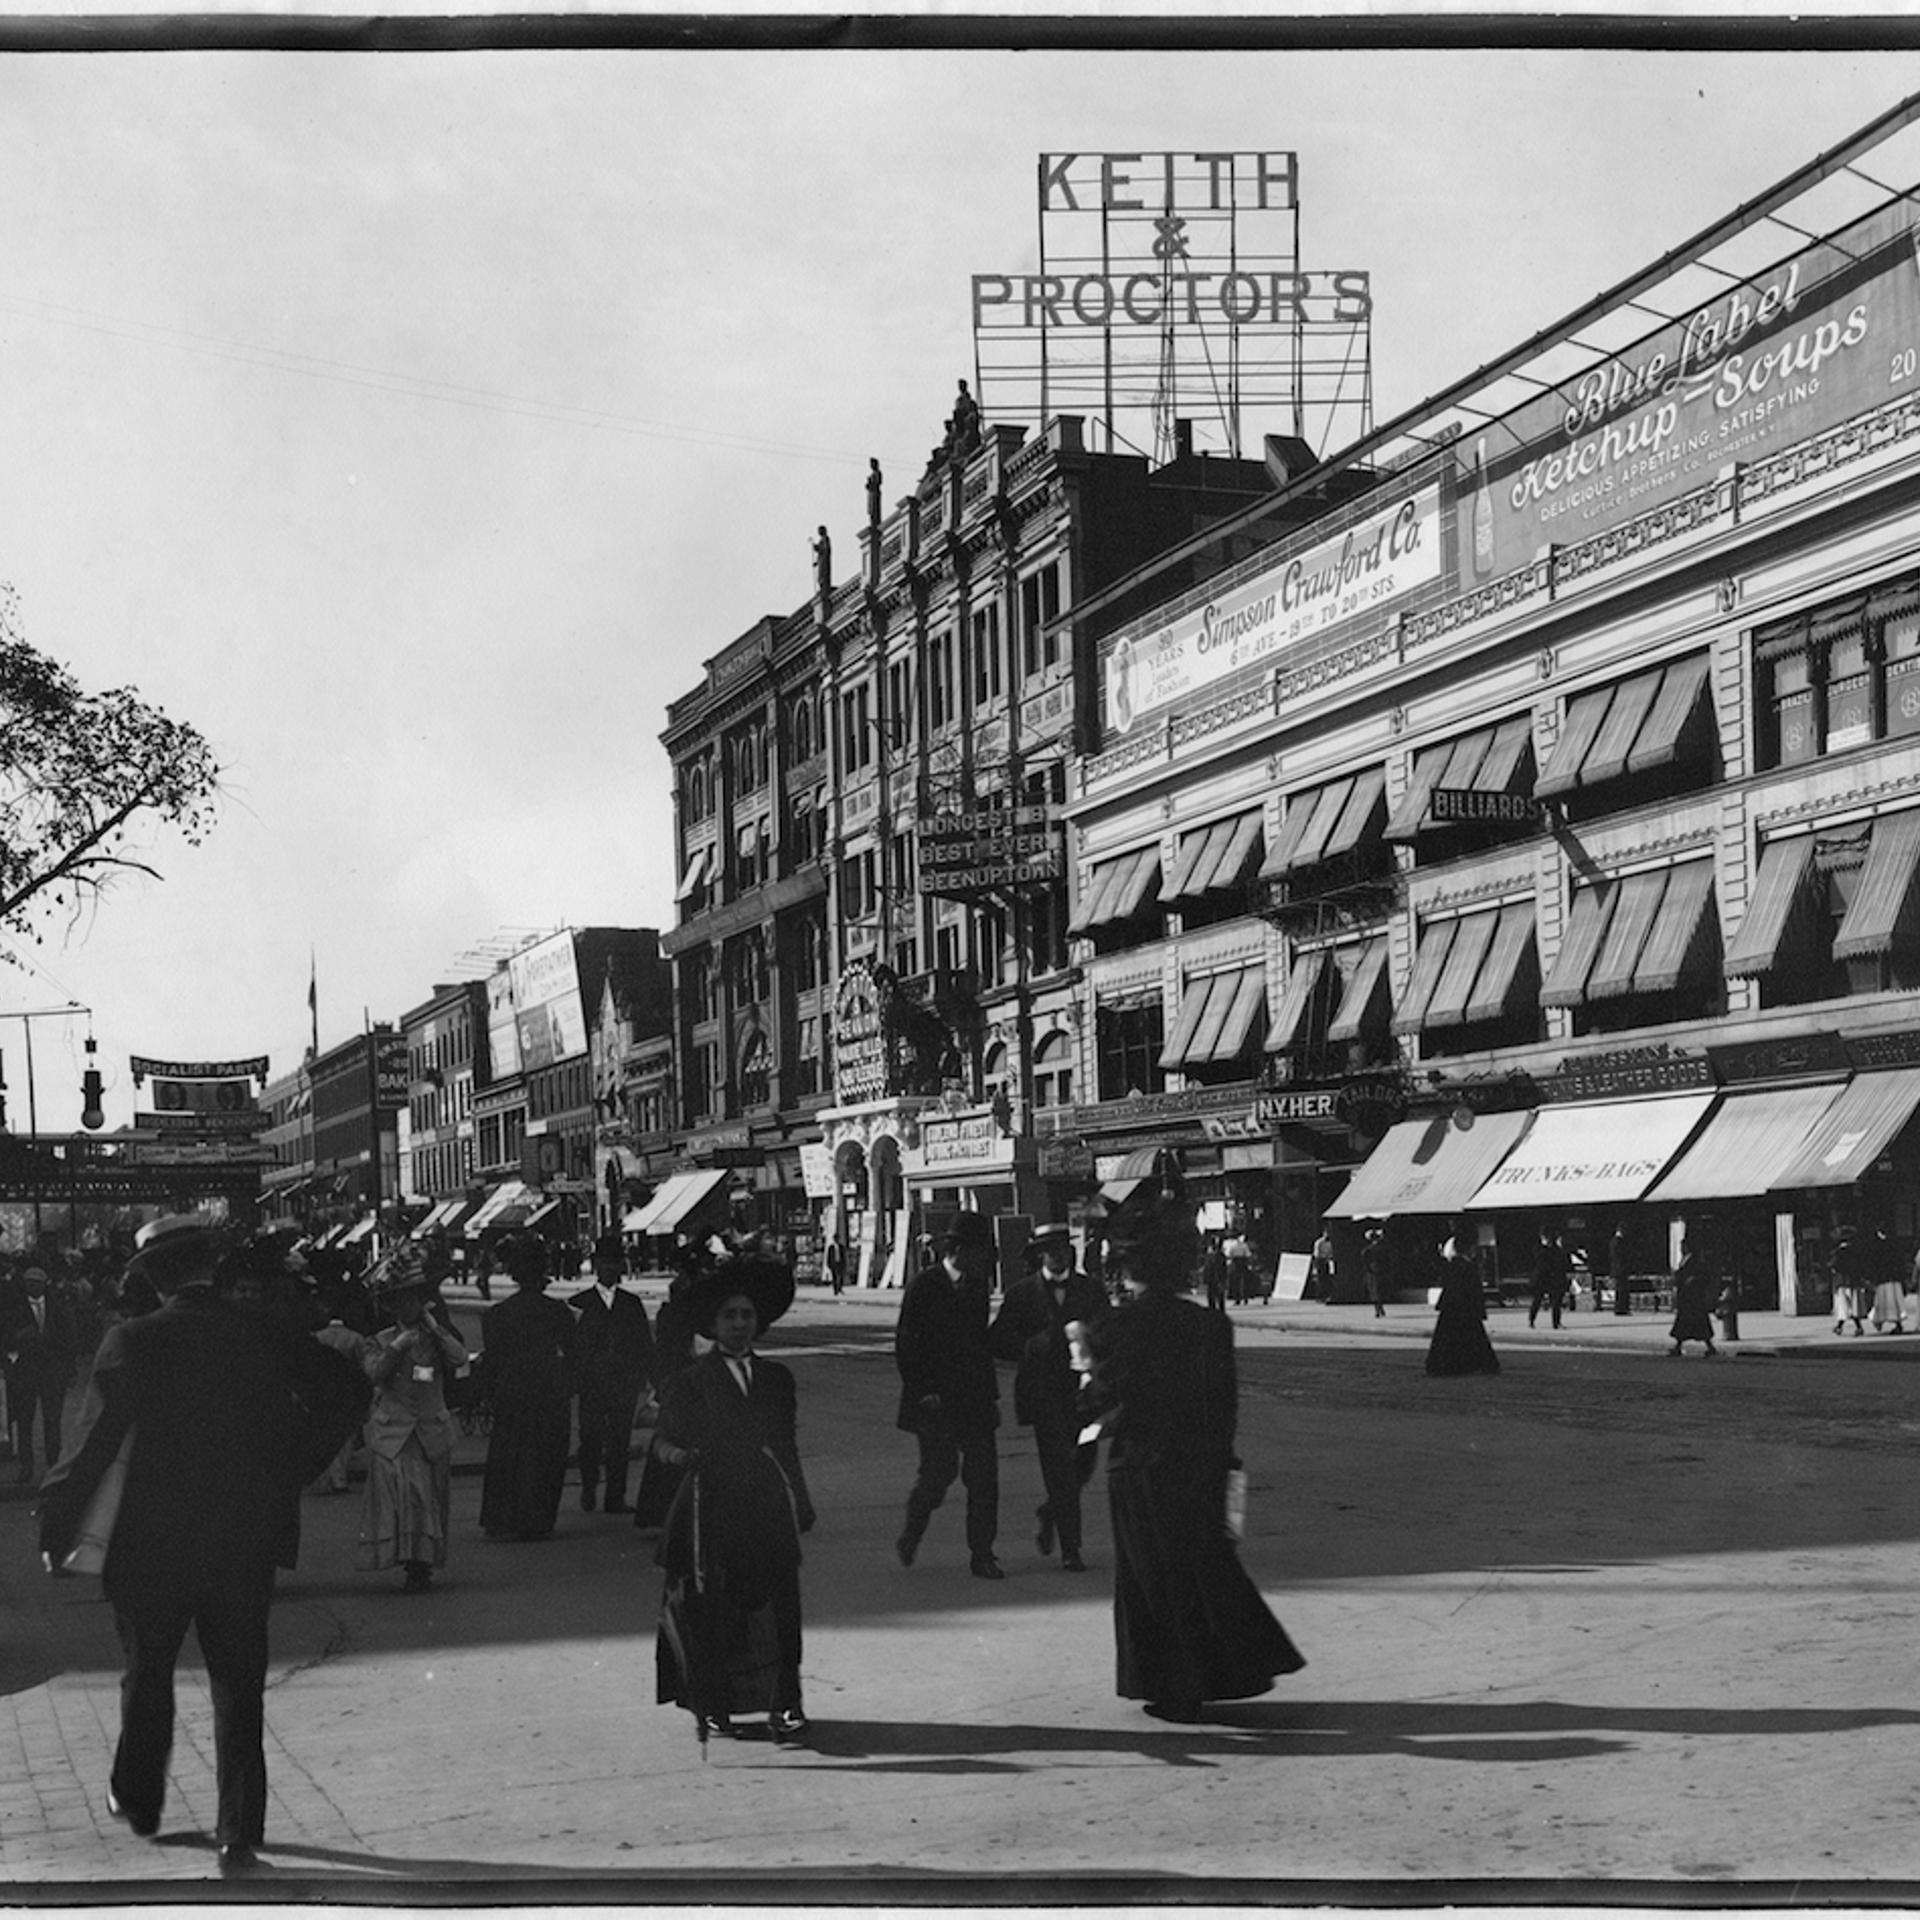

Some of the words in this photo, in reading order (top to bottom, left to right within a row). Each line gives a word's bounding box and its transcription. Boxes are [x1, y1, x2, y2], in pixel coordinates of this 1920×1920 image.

[1040, 153, 1298, 210] KEITH
[1152, 217, 1189, 258] &
[972, 271, 1372, 327] PROCTOR'S
[1564, 352, 1665, 434] Blue
[1662, 262, 1799, 396] Label
[1890, 348, 1916, 383] 20
[1511, 400, 1677, 508] Ketchup
[1716, 304, 1867, 409] Soups
[1719, 378, 1821, 438] SATISFYING
[1197, 604, 1276, 654] Simpson
[1282, 523, 1386, 612] Crawford
[1389, 500, 1422, 561] Co.
[919, 809, 1013, 837] LONGEST
[1435, 791, 1539, 820] BILLIARDS
[919, 842, 973, 865] BEST
[990, 834, 1044, 857] EVER
[133, 1058, 211, 1076] SOCIALIST
[215, 1060, 264, 1075] PARTY
[1598, 1066, 1653, 1093] LEATHER
[1657, 1061, 1708, 1085] GOODS
[1342, 1083, 1404, 1110] TAILORS
